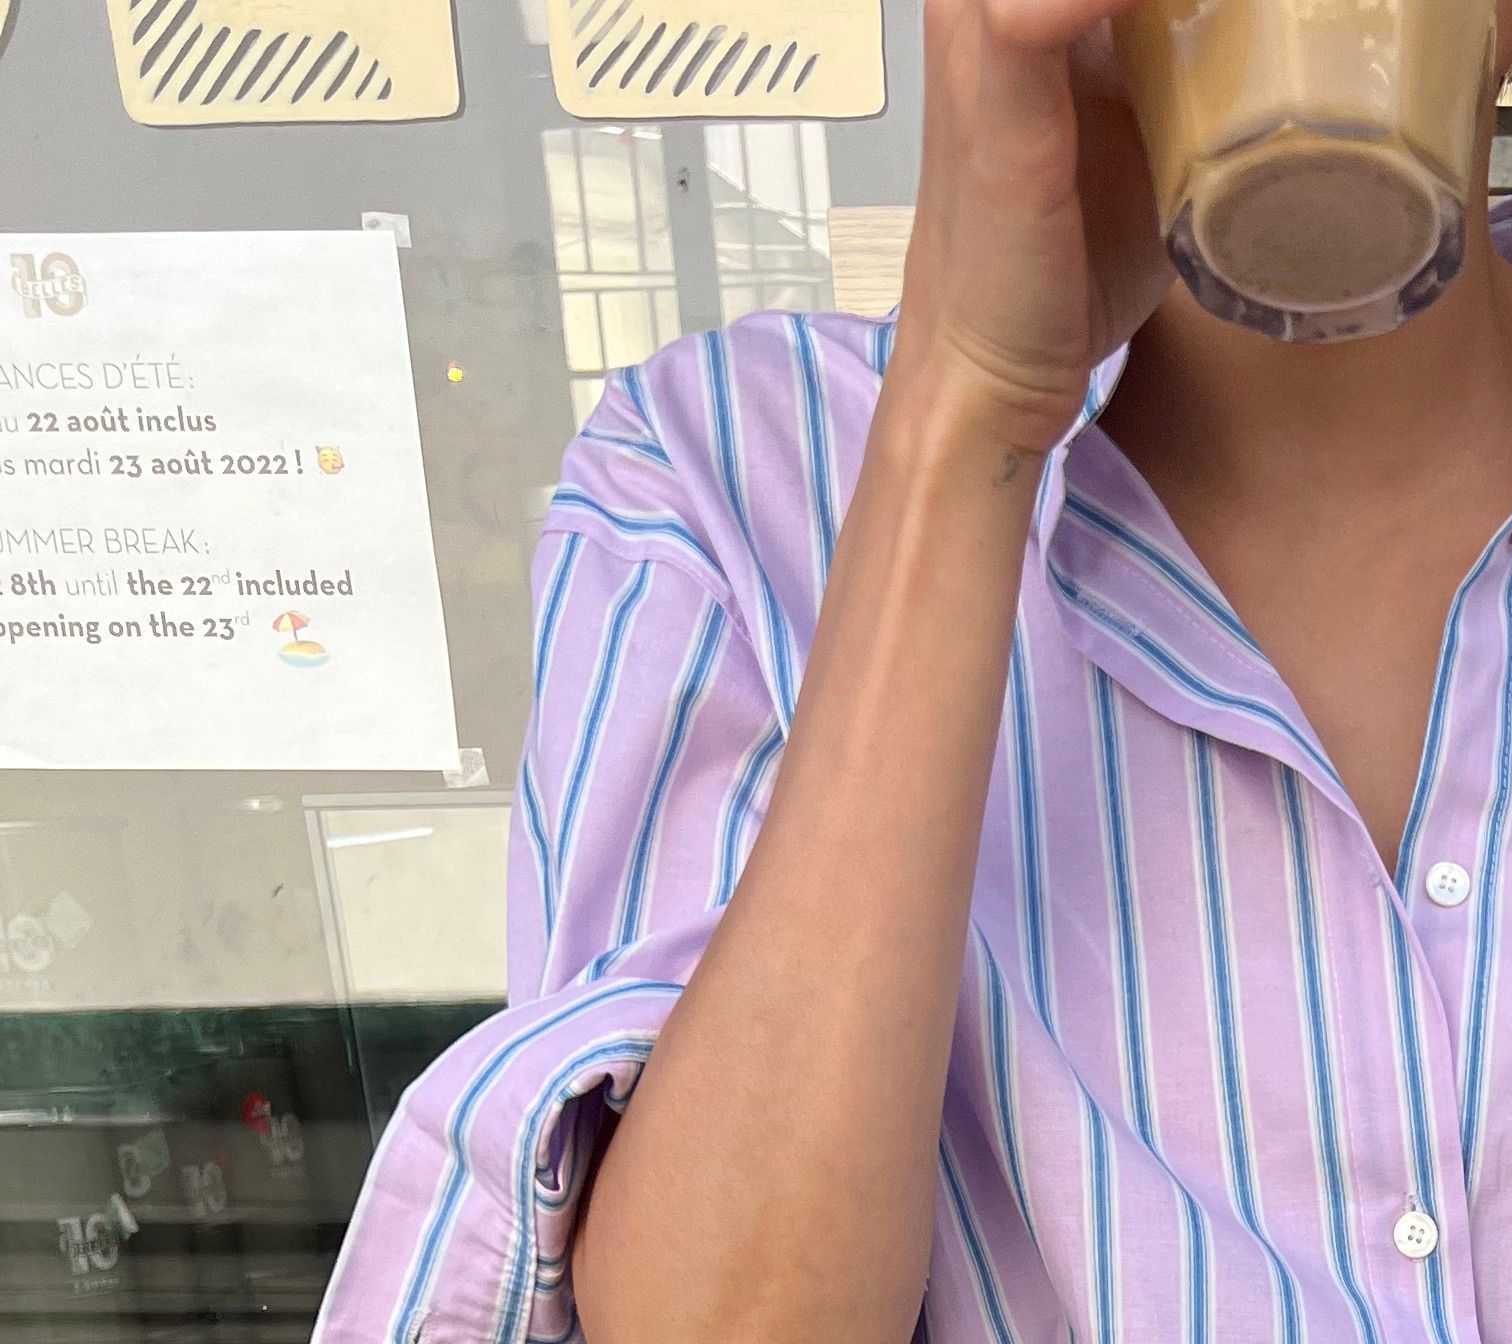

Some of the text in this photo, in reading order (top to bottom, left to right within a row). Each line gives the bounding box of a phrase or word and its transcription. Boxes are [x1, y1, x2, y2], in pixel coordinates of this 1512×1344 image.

[0, 405, 217, 433] u 22 août inclus
[24, 448, 101, 475] mardi
[109, 455, 142, 478] 23
[151, 449, 214, 475] août
[220, 454, 288, 475] 2022
[0, 528, 95, 554] MMER
[10, 569, 57, 596] 8th
[65, 569, 119, 596] until
[127, 569, 174, 596] the
[235, 569, 354, 596] included
[108, 621, 142, 637] on
[149, 611, 195, 637] the
